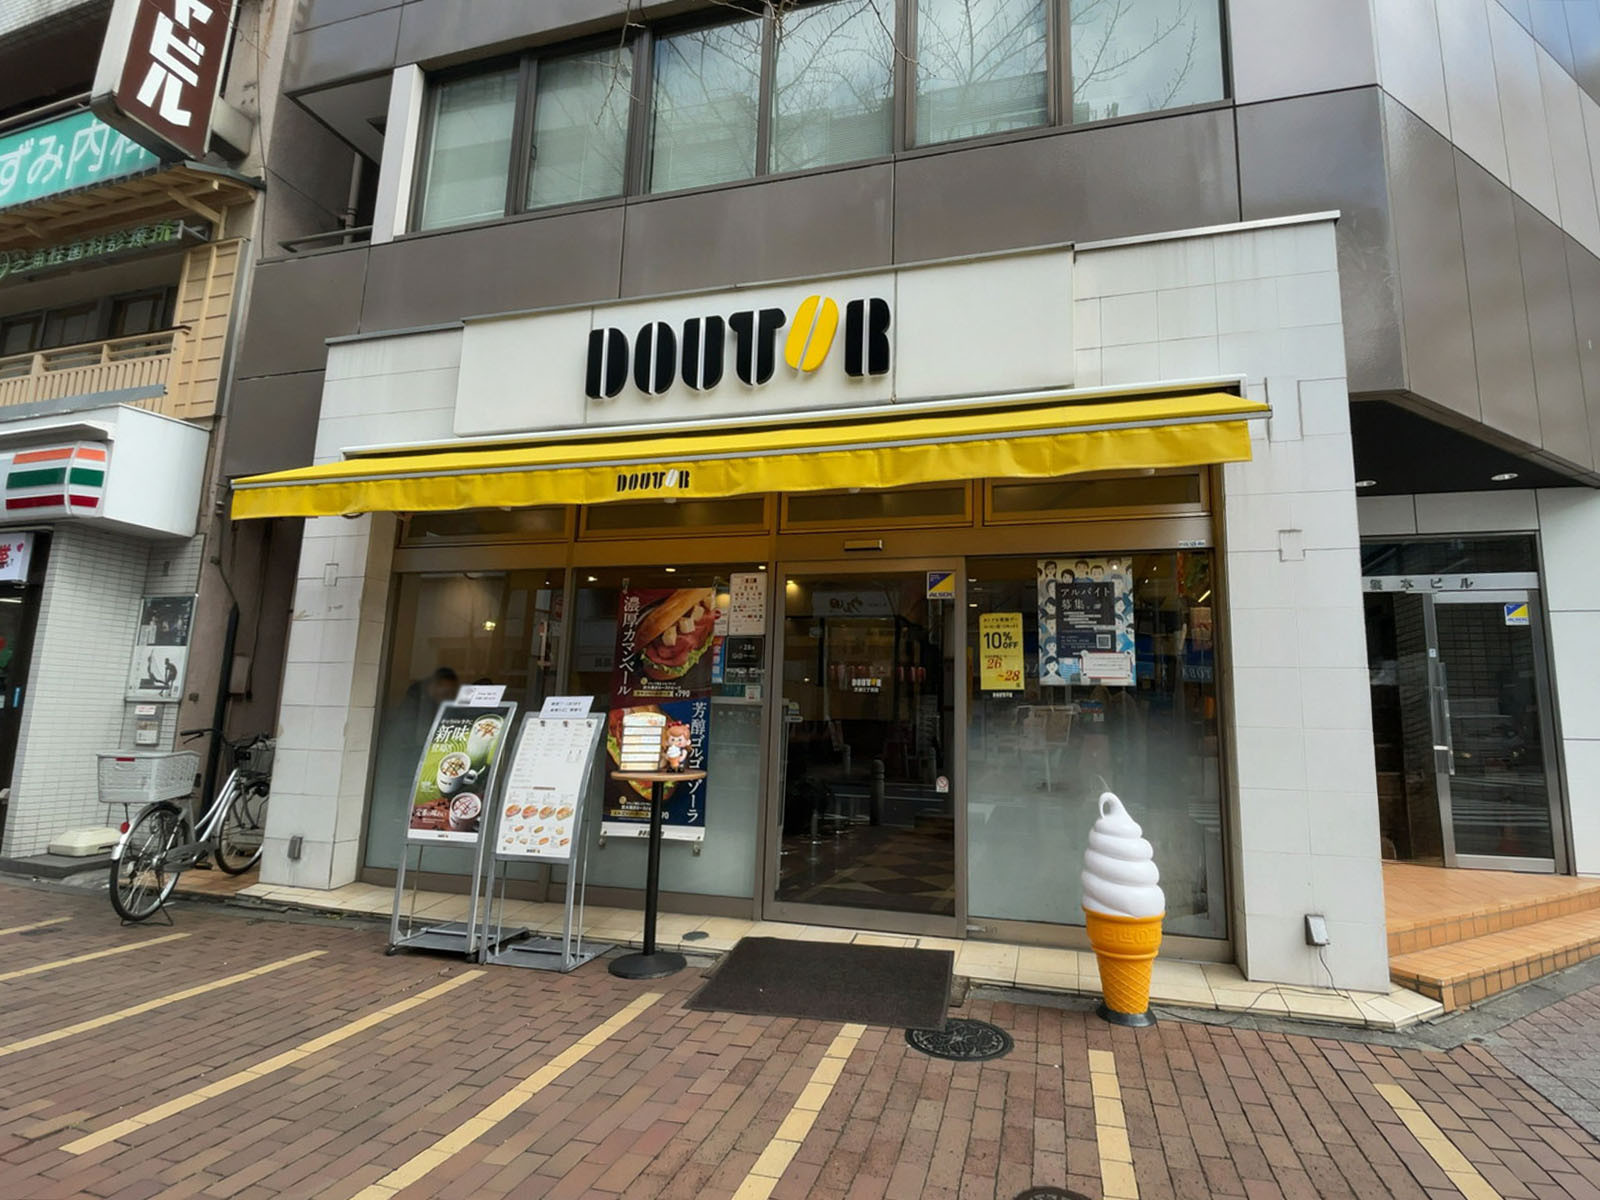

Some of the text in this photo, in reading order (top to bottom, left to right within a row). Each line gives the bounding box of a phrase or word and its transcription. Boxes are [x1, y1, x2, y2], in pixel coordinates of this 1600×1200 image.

[585, 295, 890, 399] DOUTOR
[617, 468, 690, 492] DOUTOR
[1060, 586, 1111, 598] アルバイト
[617, 596, 640, 695] 濃厚カマンベール
[1003, 640, 1018, 650] OFF
[986, 657, 1003, 670] 26
[434, 724, 470, 744] 新味
[687, 702, 707, 823] 芳醇ゴルゴゾーラ
